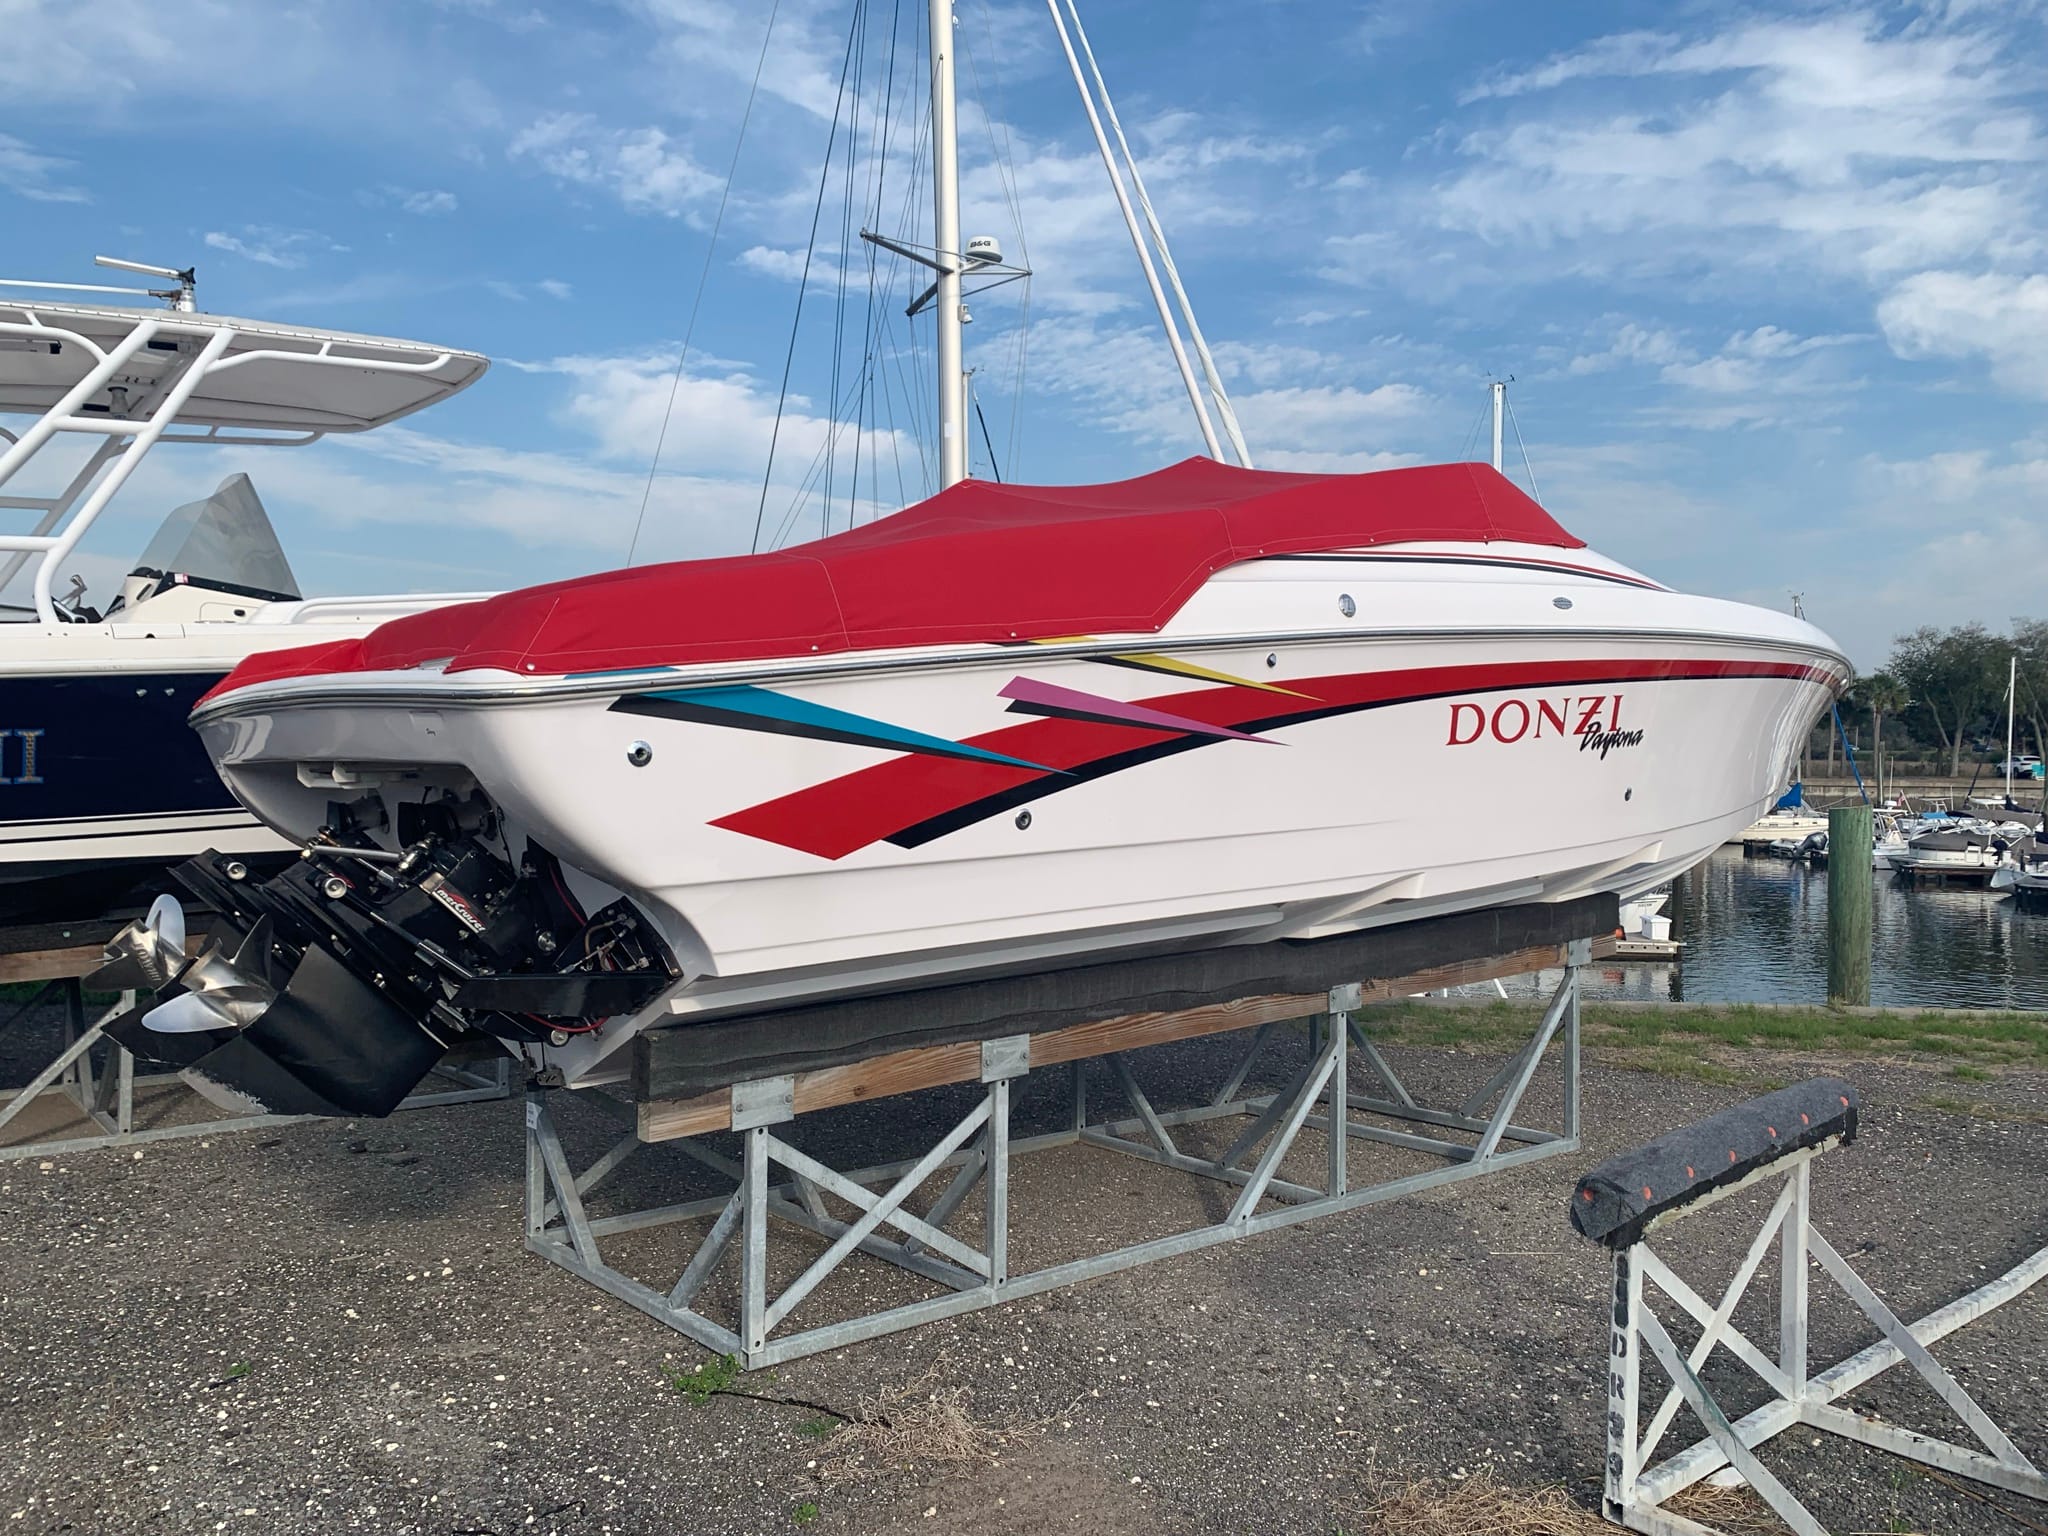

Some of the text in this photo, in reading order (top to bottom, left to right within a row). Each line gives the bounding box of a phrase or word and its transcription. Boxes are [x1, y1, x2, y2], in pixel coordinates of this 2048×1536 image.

[970, 240, 991, 248] B&G
[1445, 694, 1624, 746] DONZI
[1579, 721, 1644, 760] Daytona
